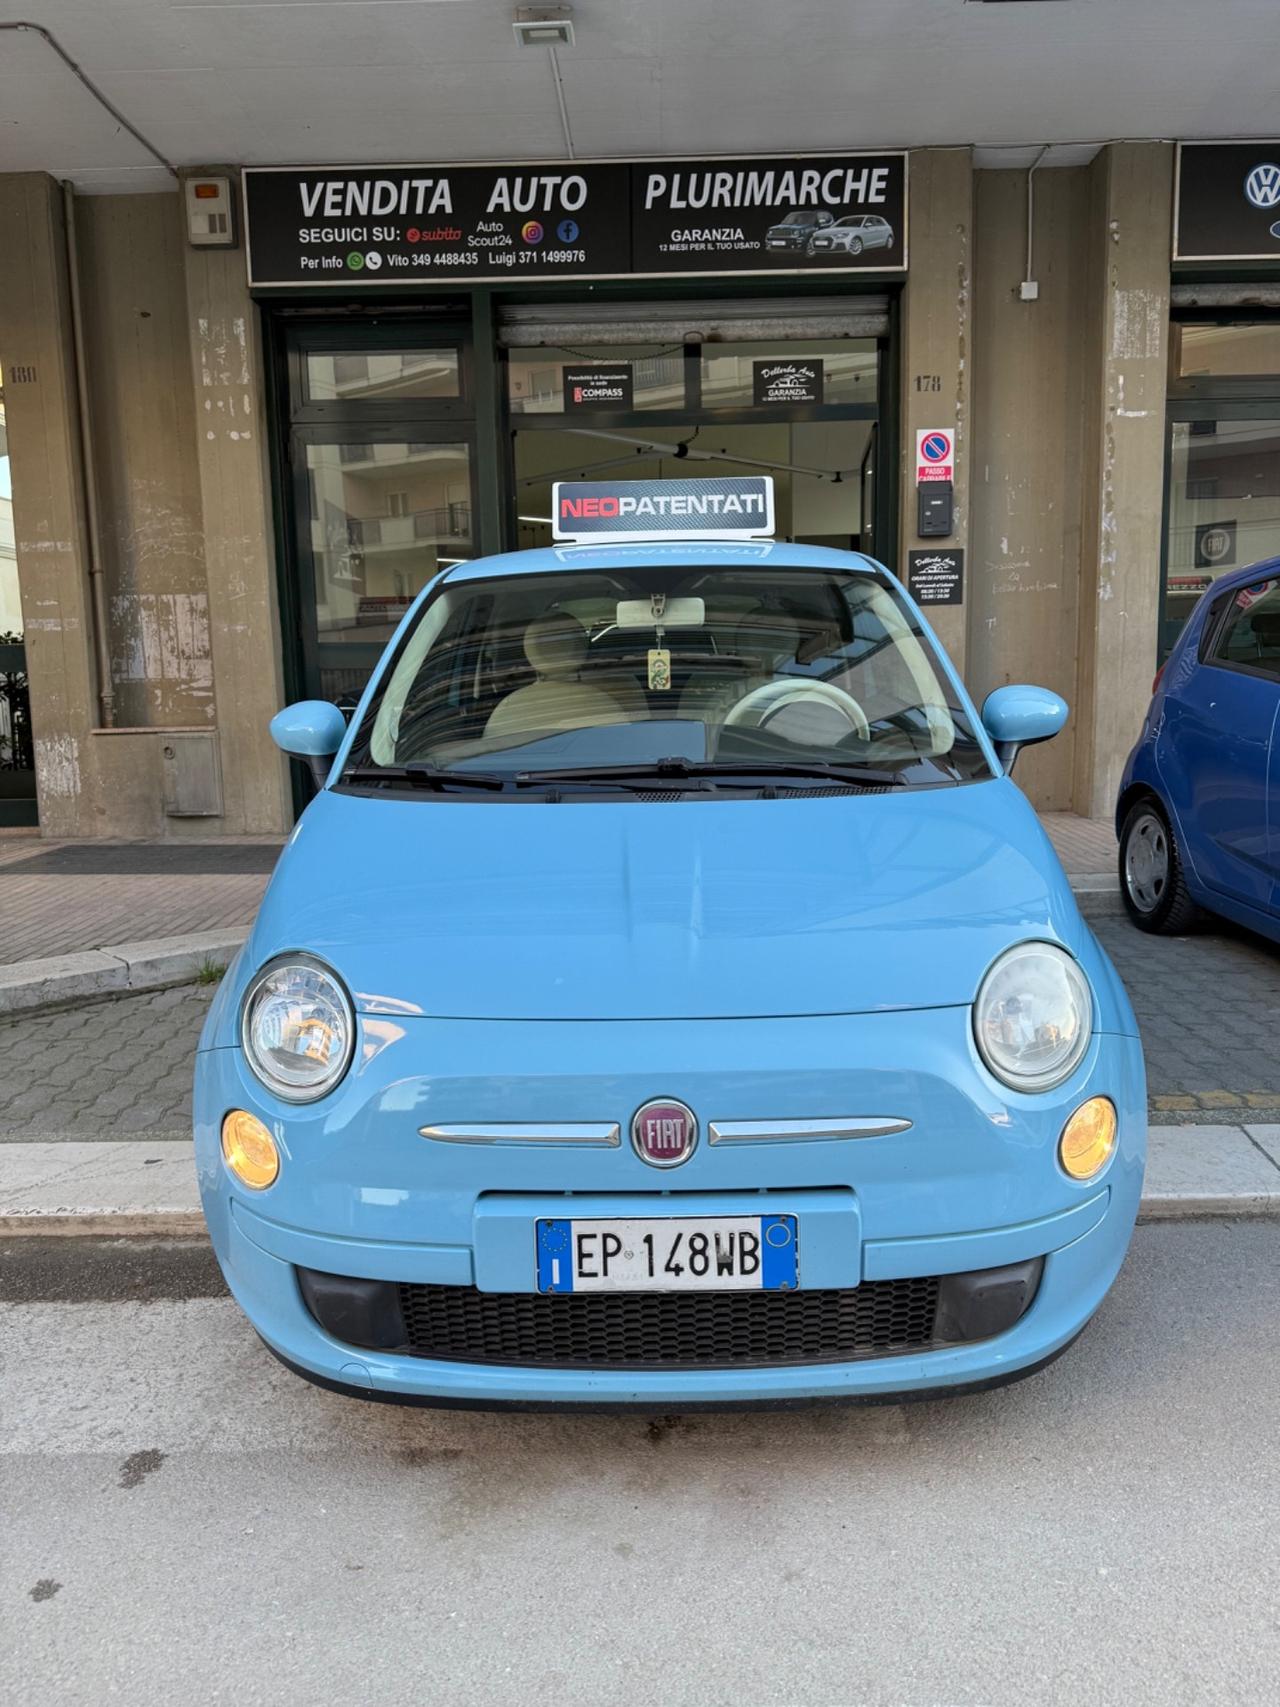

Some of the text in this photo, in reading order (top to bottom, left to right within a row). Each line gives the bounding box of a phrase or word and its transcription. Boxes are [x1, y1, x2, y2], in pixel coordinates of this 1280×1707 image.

[300, 168, 889, 217] VENDITA AUTO PLURIMARCHE
[476, 221, 504, 232] Auto
[299, 227, 463, 243] SEGUICI SU: subito
[467, 235, 513, 247] Scout24
[671, 228, 744, 242] GARANZIA
[669, 243, 688, 251] MESI
[690, 243, 705, 251] PER
[716, 242, 732, 250] TUO
[734, 241, 760, 249] USATO
[300, 250, 586, 269] Per Info Vito 349 4488435 Luigi 371 1499976
[913, 375, 941, 392] 178
[582, 388, 623, 397] COMPASS
[768, 389, 807, 397] GARANZIA
[925, 467, 945, 475] PASSO
[561, 493, 764, 518] NEOPATENTATI
[1208, 536, 1224, 553] FIAT
[647, 1119, 684, 1149] FIAT
